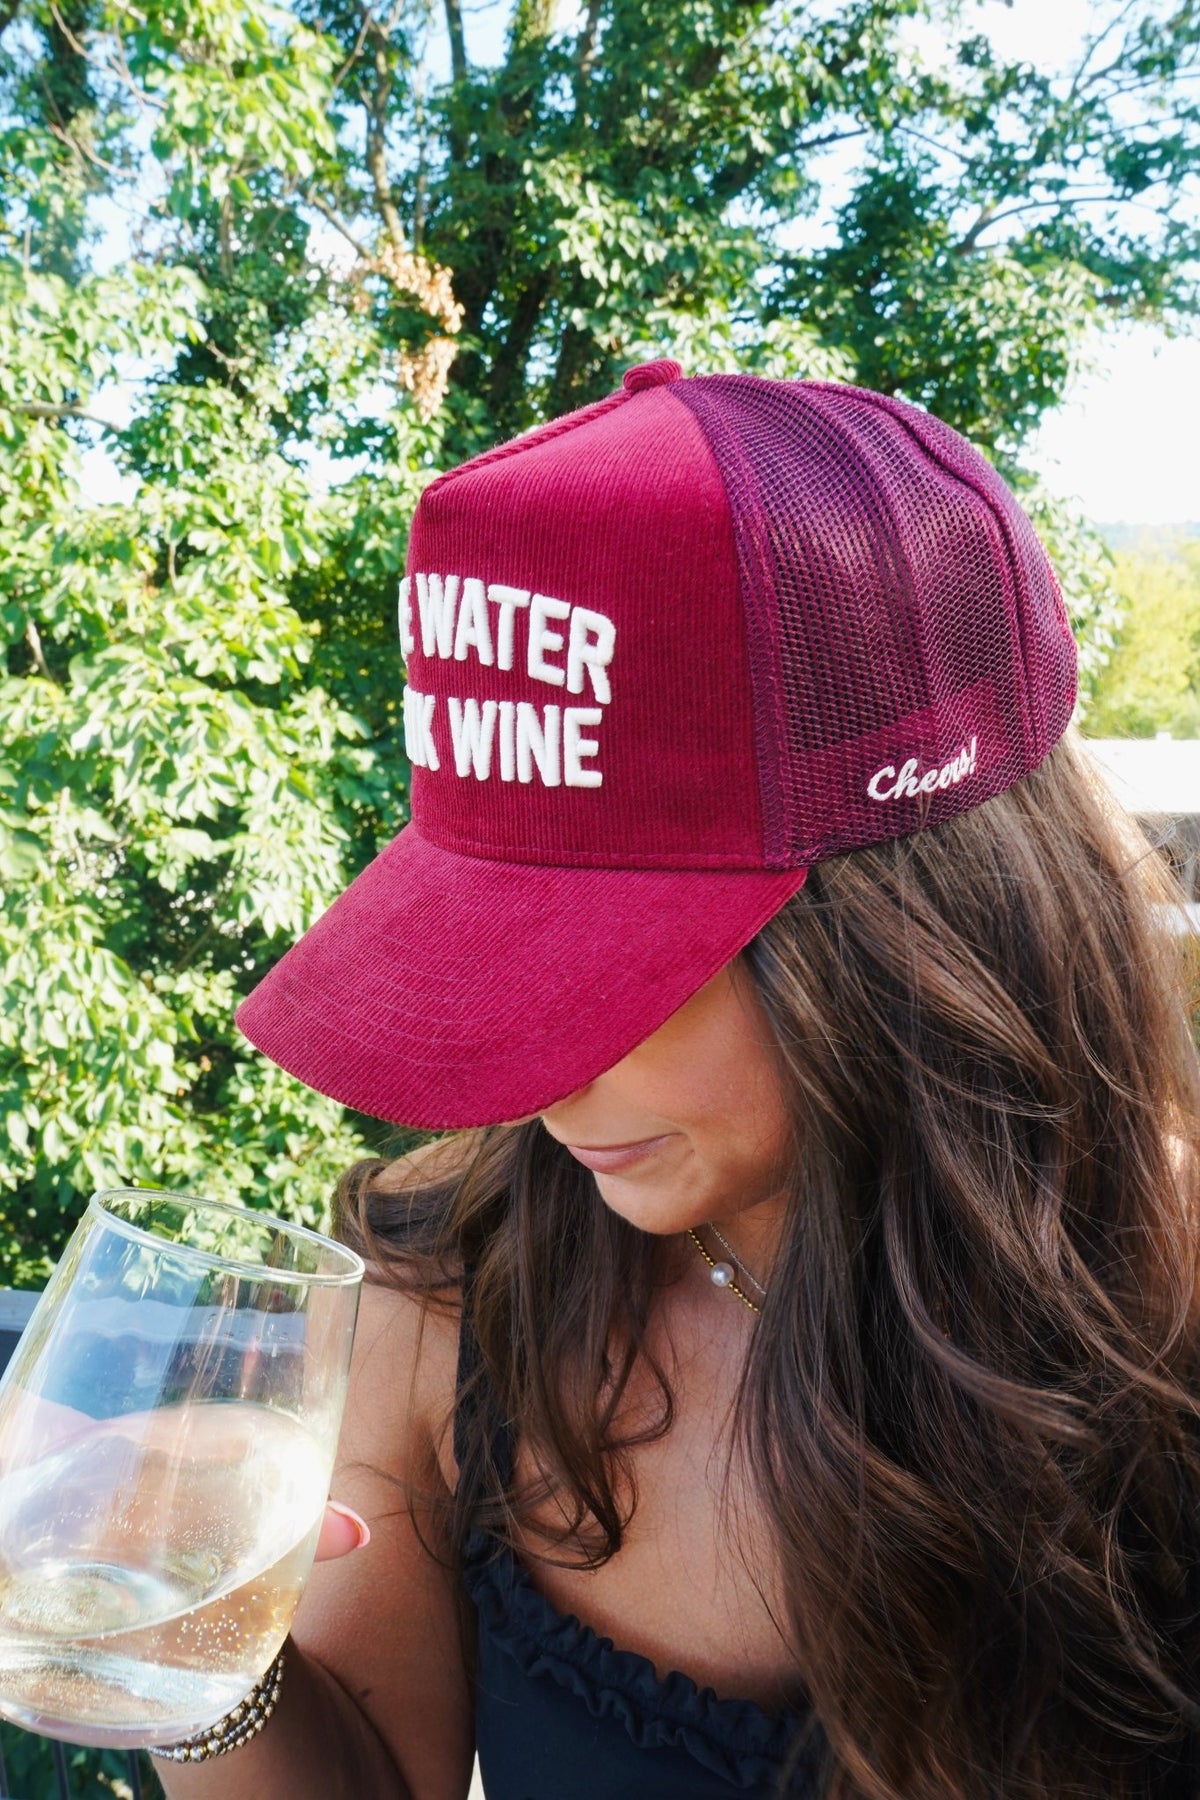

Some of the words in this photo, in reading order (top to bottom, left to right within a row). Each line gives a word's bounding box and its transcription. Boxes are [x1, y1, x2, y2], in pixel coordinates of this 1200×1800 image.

[415, 572, 616, 705] WATER
[447, 697, 603, 788] WINE
[867, 735, 978, 802] Cheers!
